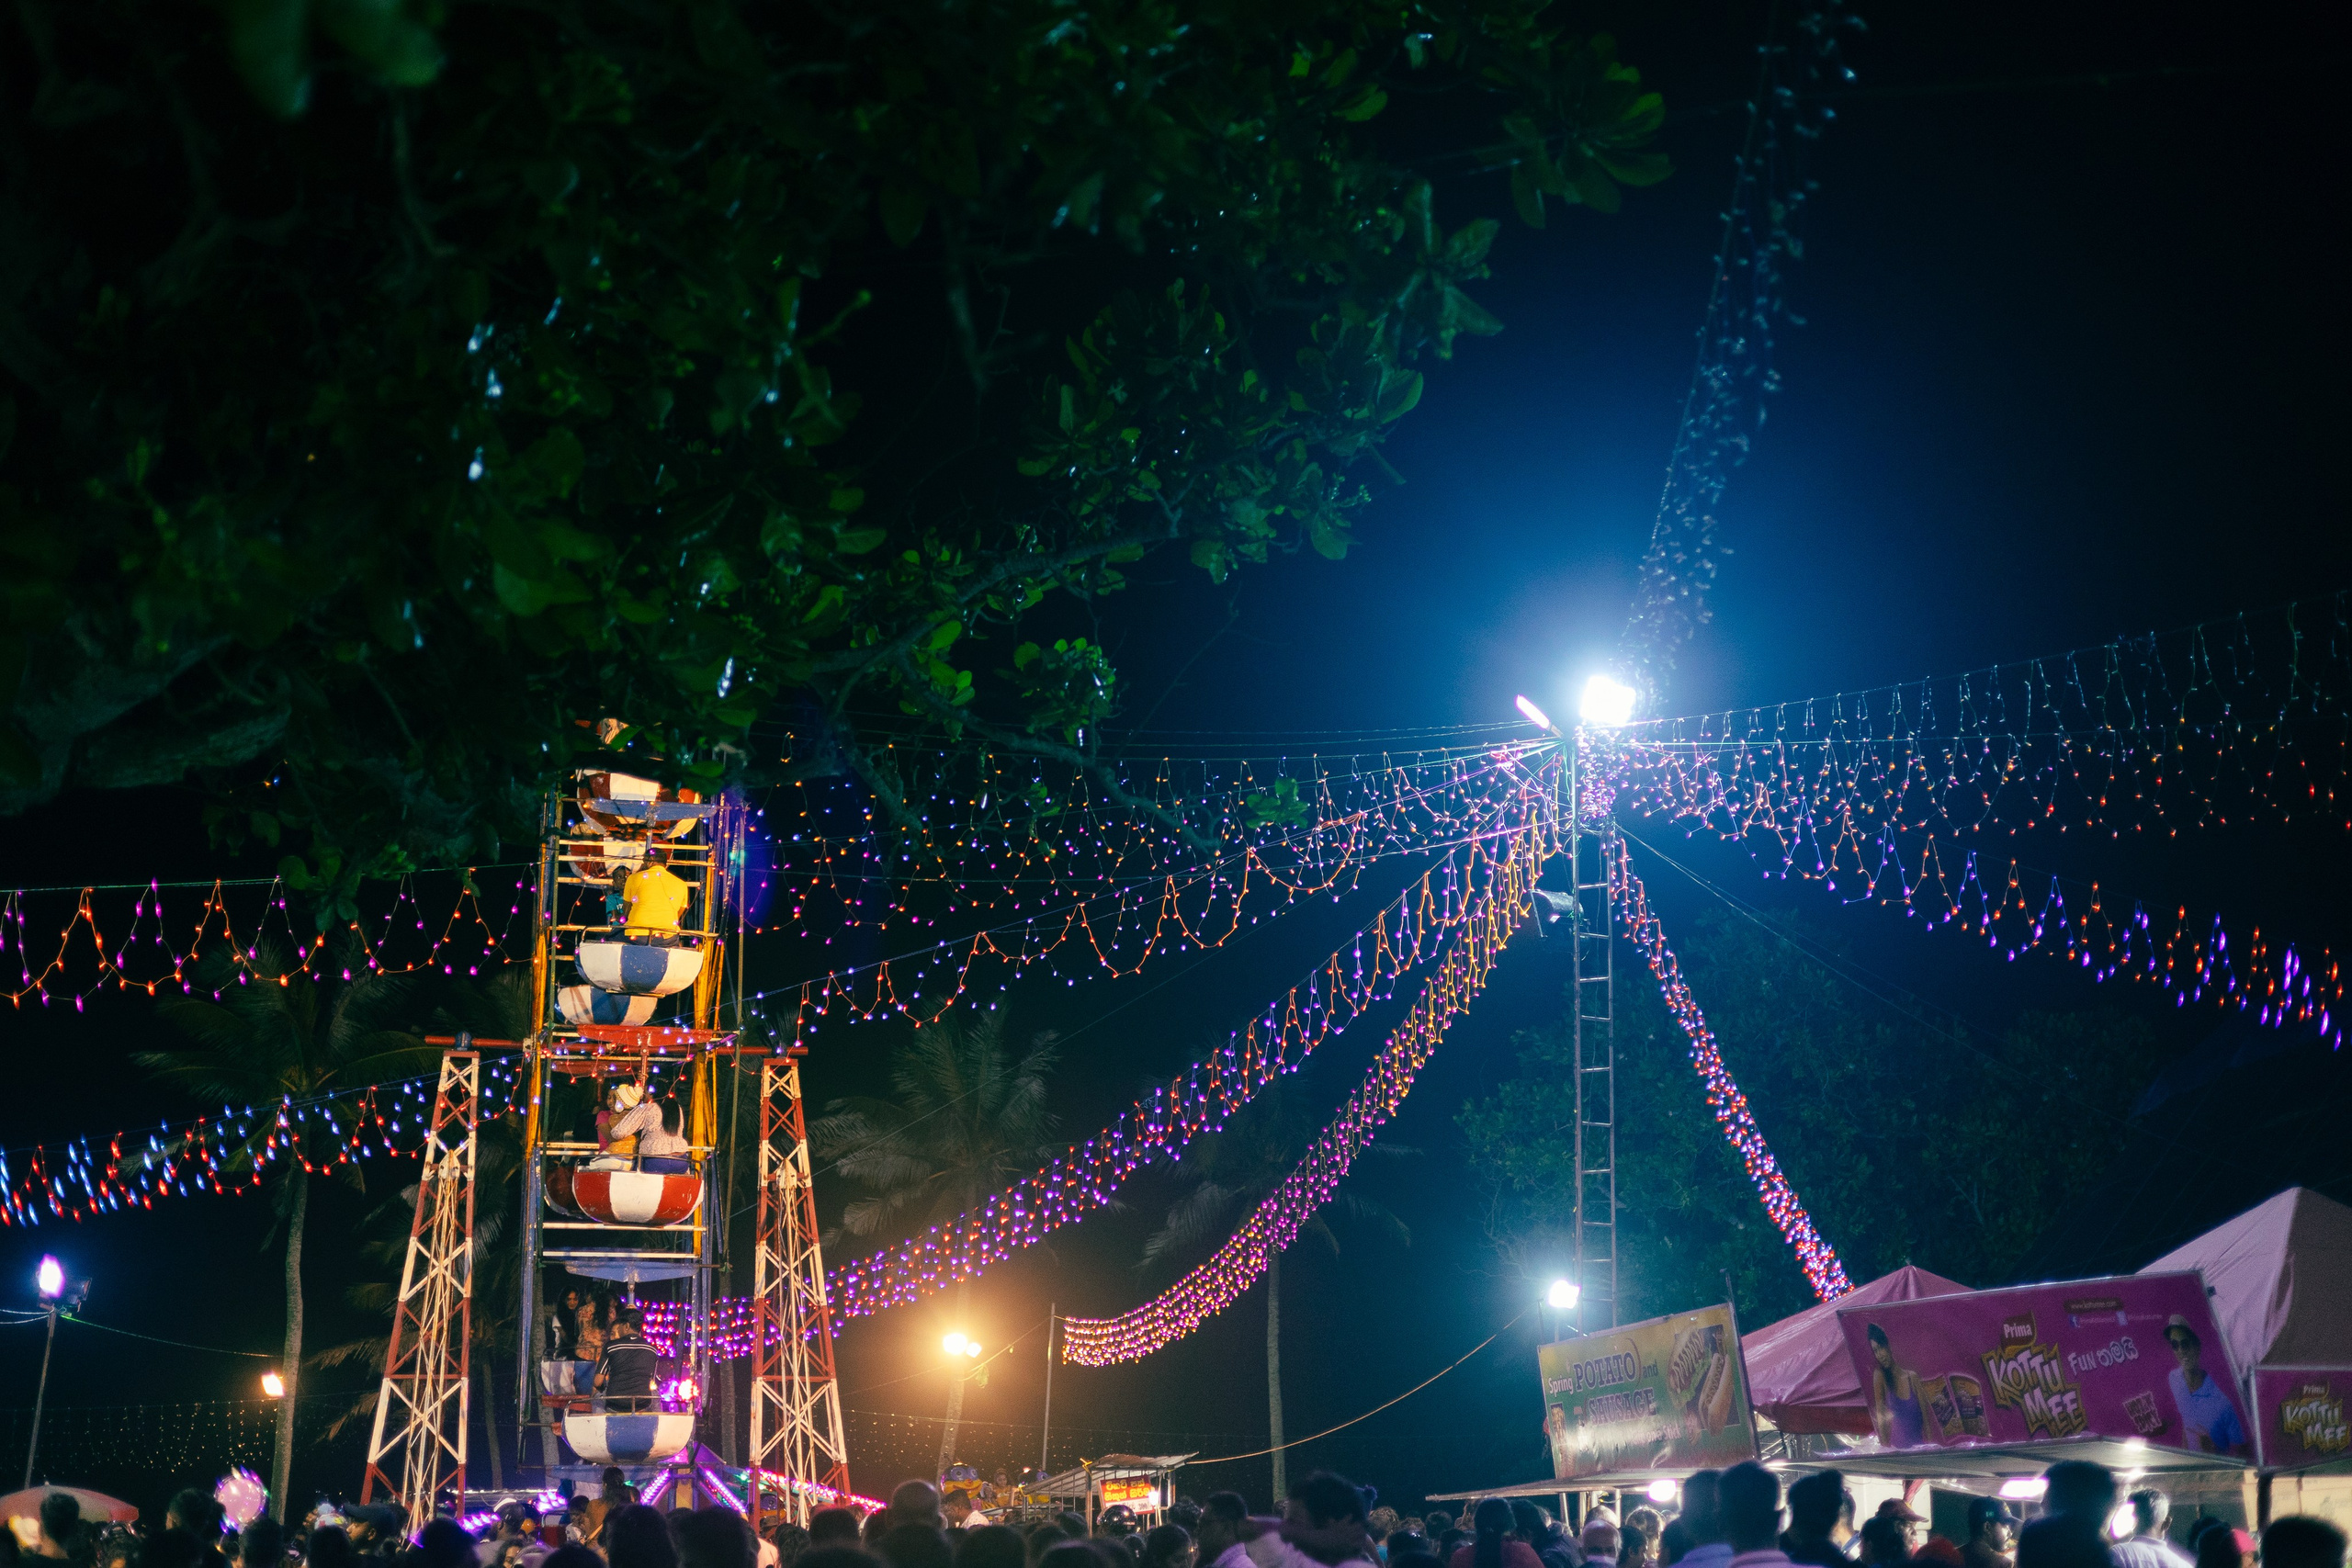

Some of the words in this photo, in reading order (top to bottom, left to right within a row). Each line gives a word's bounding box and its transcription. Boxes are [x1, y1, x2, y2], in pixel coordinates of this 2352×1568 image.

[2003, 1323, 2032, 1338] Prima
[1548, 1375, 1574, 1396] Spring
[1573, 1351, 1636, 1393] POTATO
[1643, 1360, 1658, 1378] and
[1988, 1348, 2062, 1394] KOTTU
[2303, 1384, 2325, 1394] Prima
[1588, 1387, 1657, 1425] SAUSAGE
[2023, 1386, 2079, 1426] MEE
[2285, 1400, 2339, 1427] KOTTU
[1663, 1423, 1681, 1440] Stick
[2306, 1422, 2347, 1445] MEE
